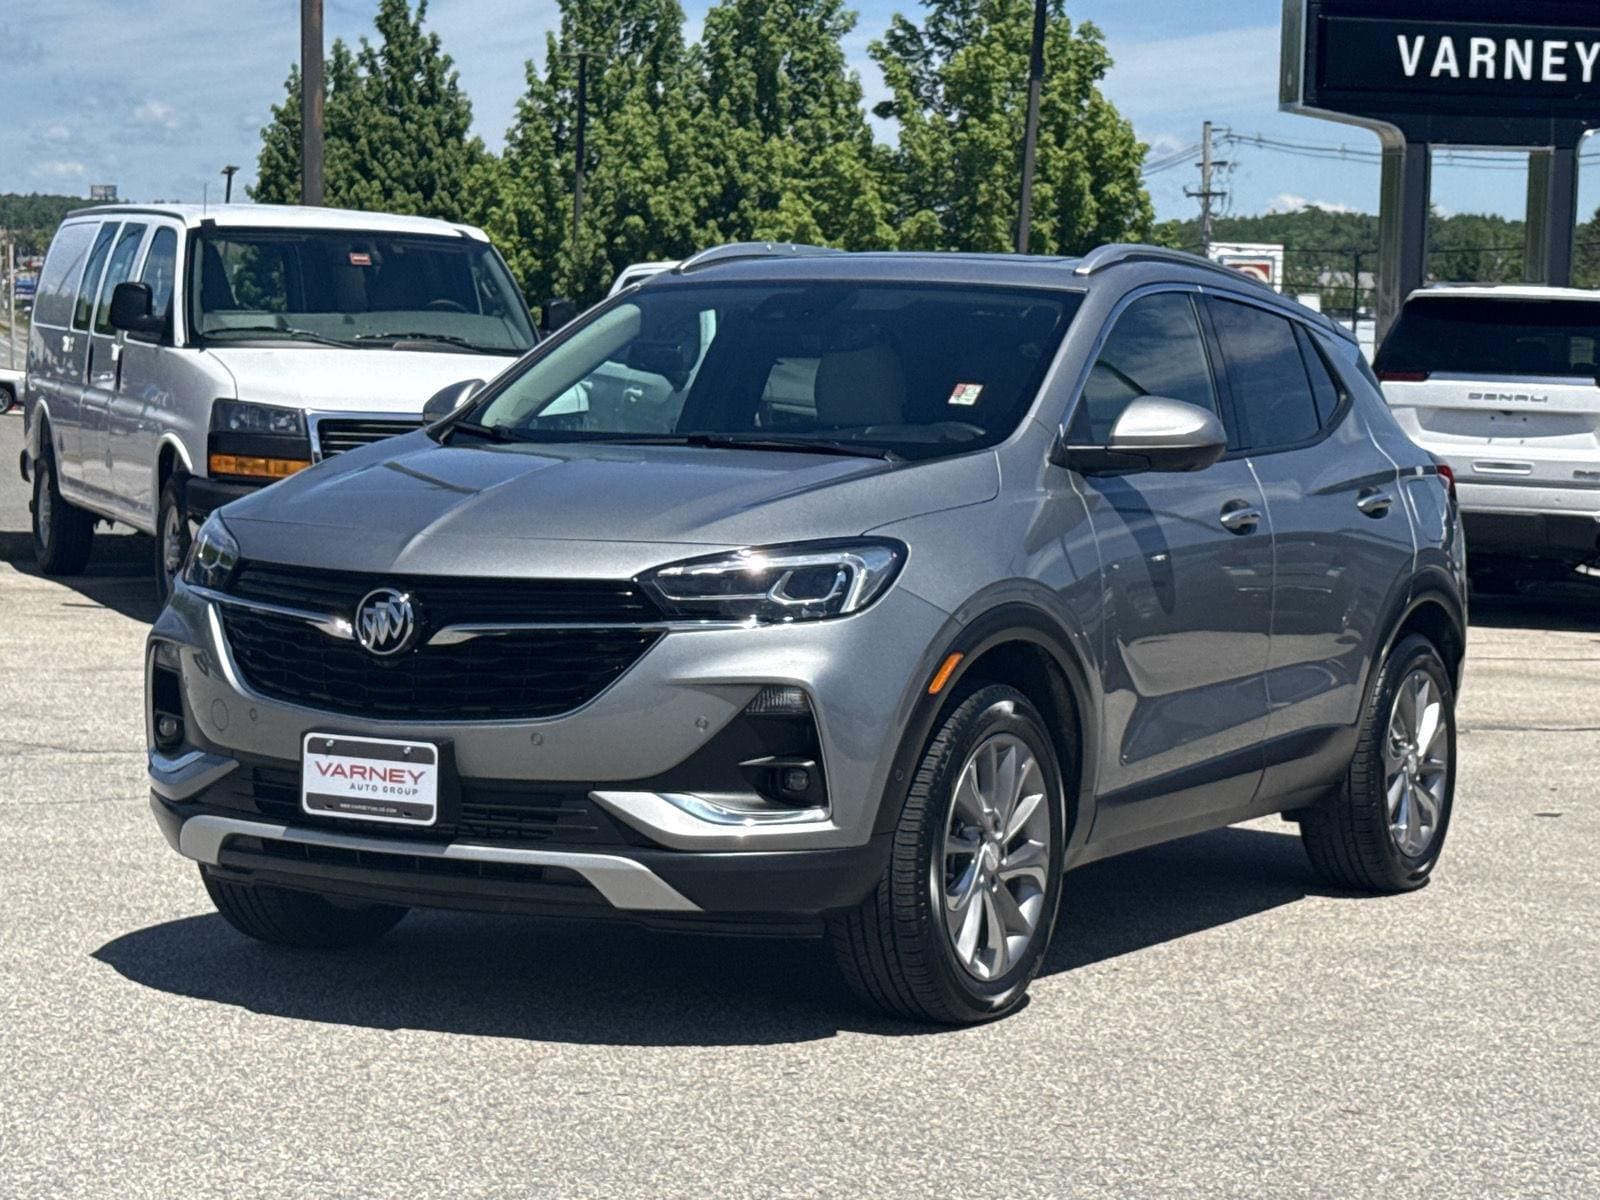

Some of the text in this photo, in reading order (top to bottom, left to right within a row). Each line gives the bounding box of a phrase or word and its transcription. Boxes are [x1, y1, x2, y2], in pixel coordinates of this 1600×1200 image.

[1397, 34, 1600, 83] VARNEY
[1468, 392, 1548, 403] DENALI
[315, 761, 426, 785] VARNEY
[349, 782, 419, 796] AUTO GROUP
